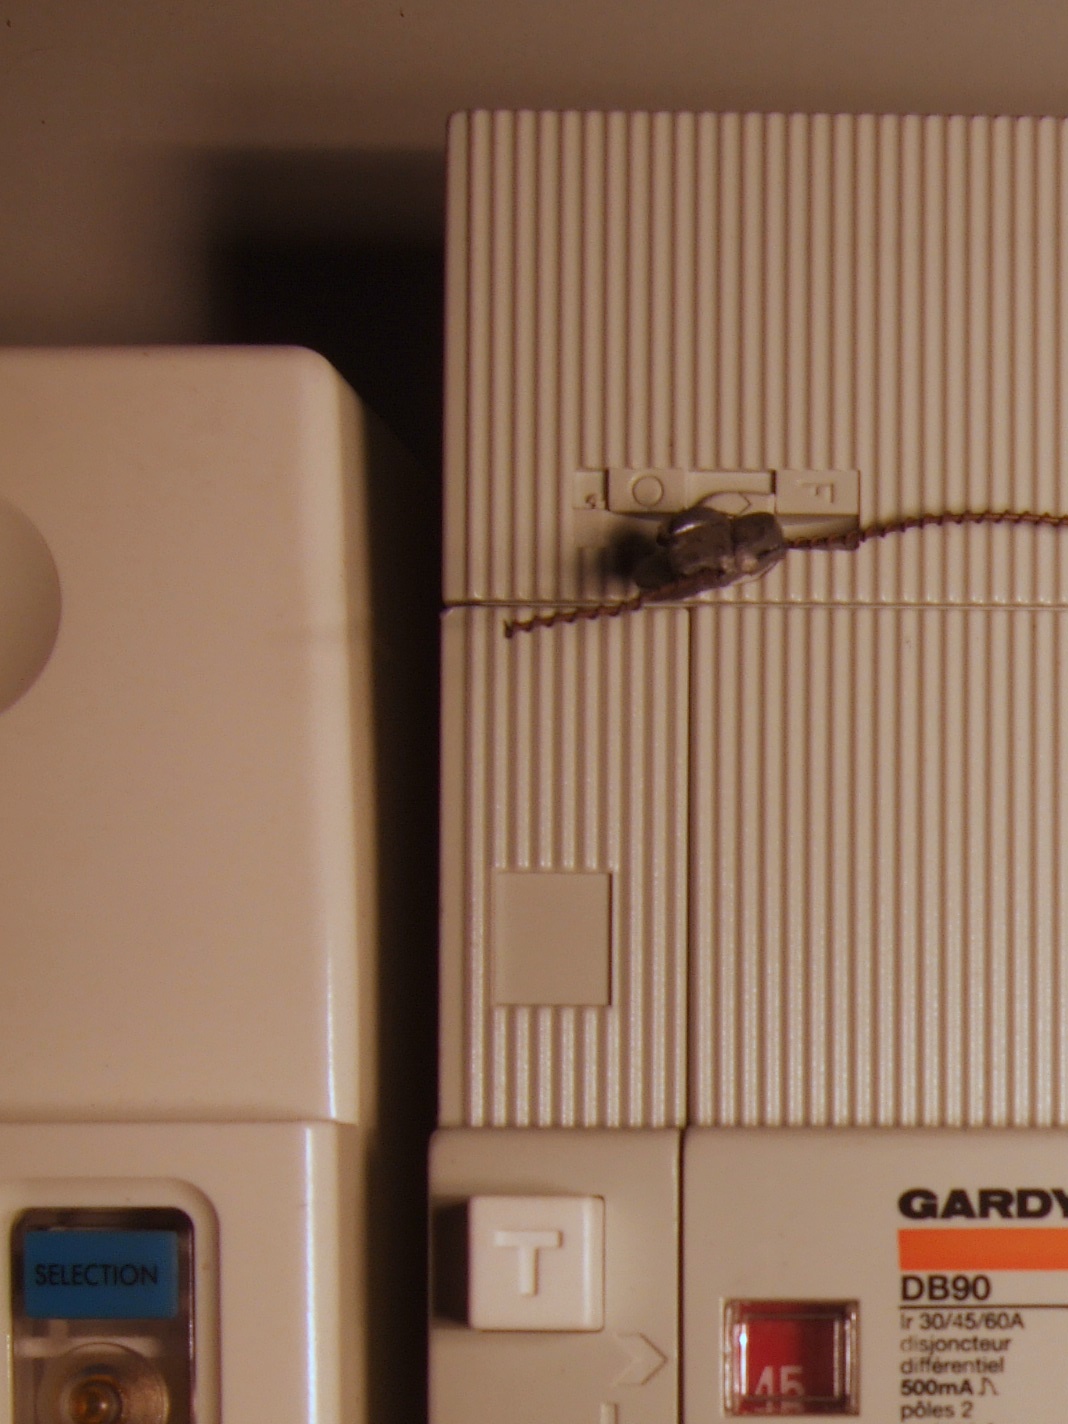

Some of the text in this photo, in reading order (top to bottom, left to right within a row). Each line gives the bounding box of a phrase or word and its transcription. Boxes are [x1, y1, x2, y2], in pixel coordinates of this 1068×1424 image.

[34, 1263, 160, 1287] SELECTION
[901, 1275, 992, 1301] DB90
[919, 1312, 1025, 1330] 30/45/60A
[900, 1335, 1012, 1356] disjoncteur
[901, 1379, 974, 1397] 500mA
[901, 1400, 974, 1423] pôles 2
